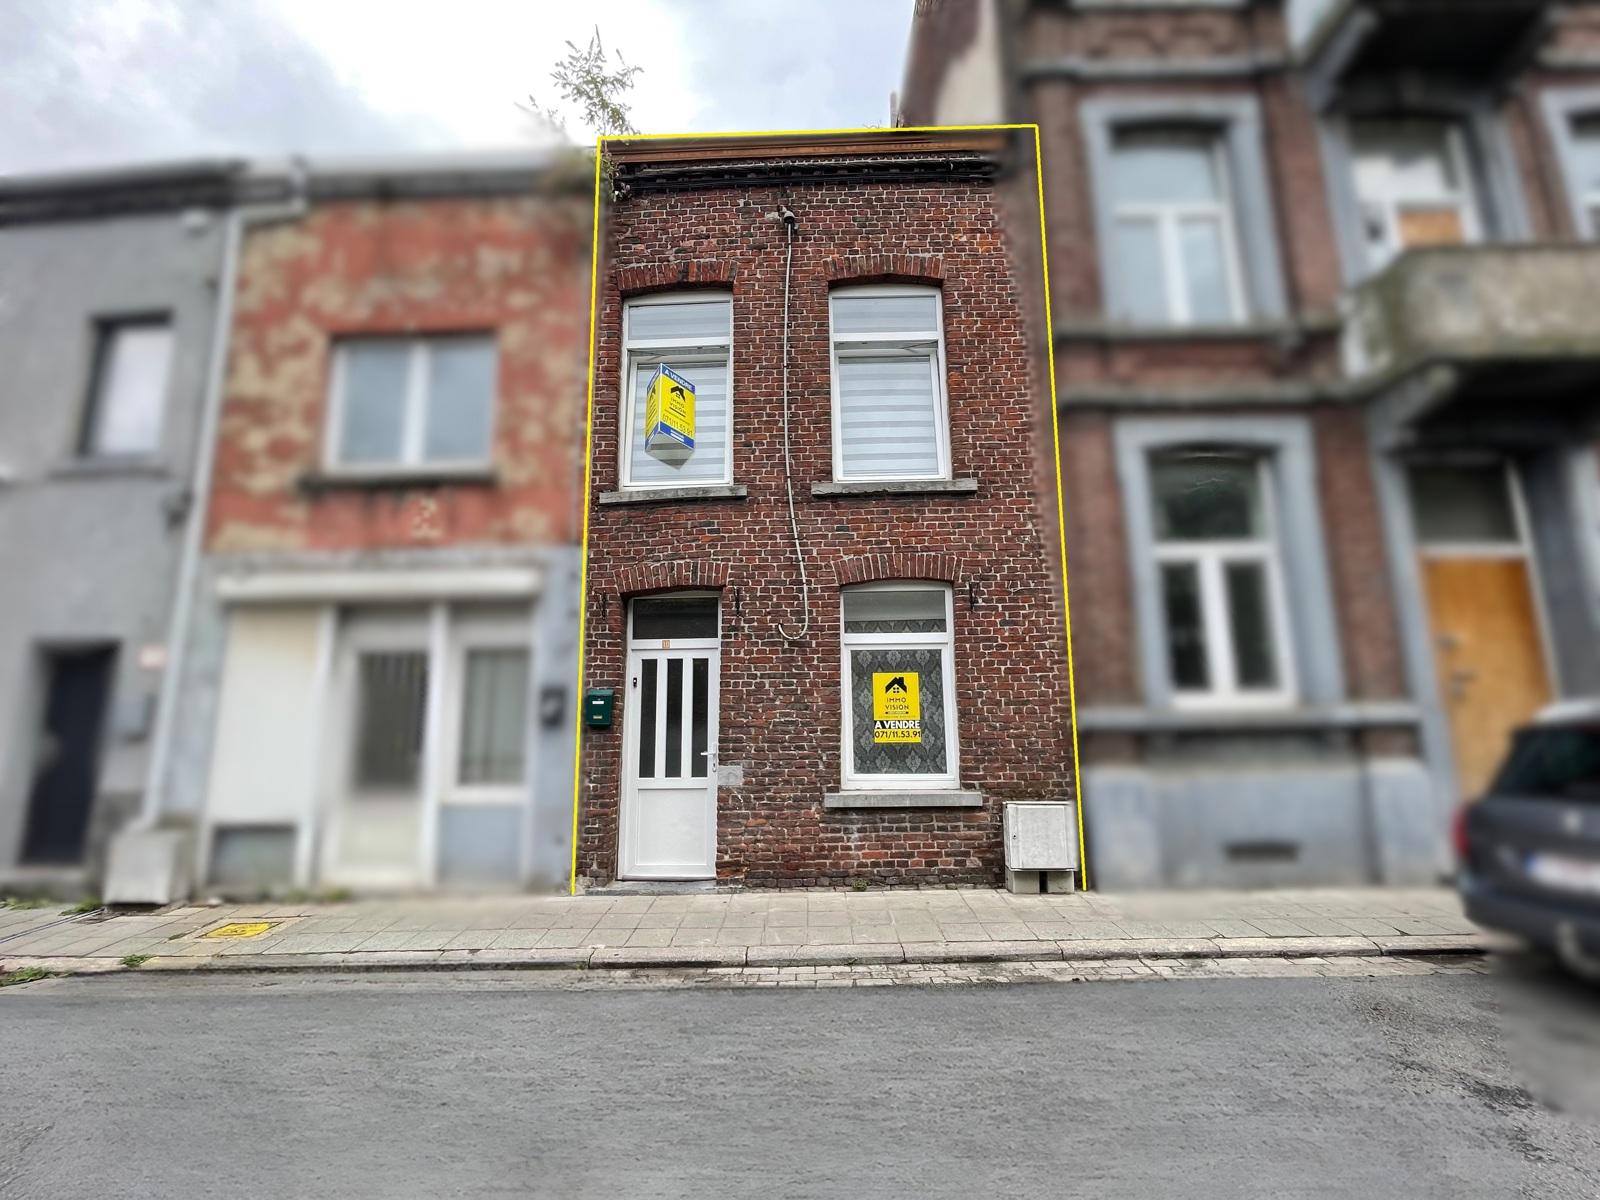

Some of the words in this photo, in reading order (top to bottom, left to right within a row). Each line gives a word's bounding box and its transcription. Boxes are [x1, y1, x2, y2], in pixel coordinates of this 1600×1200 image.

[875, 720, 882, 729] A
[884, 720, 920, 729] VENDRE
[874, 730, 921, 739] 071/11.53.91
